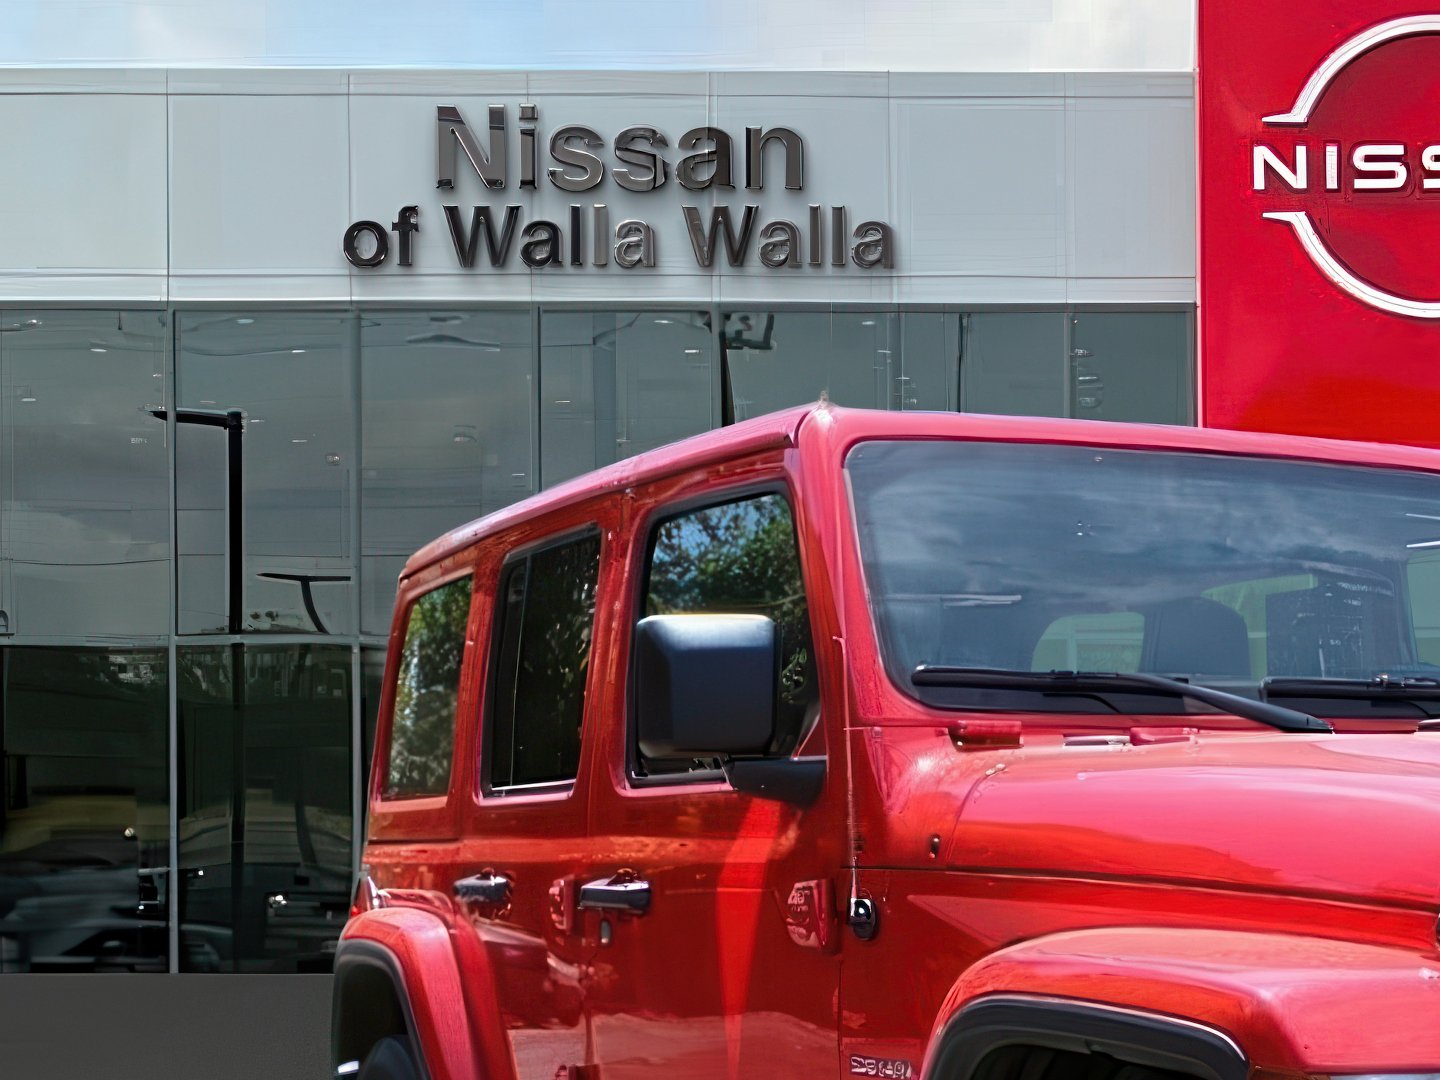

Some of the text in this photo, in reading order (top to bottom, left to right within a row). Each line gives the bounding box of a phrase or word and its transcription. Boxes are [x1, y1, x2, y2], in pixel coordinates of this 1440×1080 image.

[435, 103, 805, 191] Nissan
[342, 204, 897, 270] of Walla Walla
